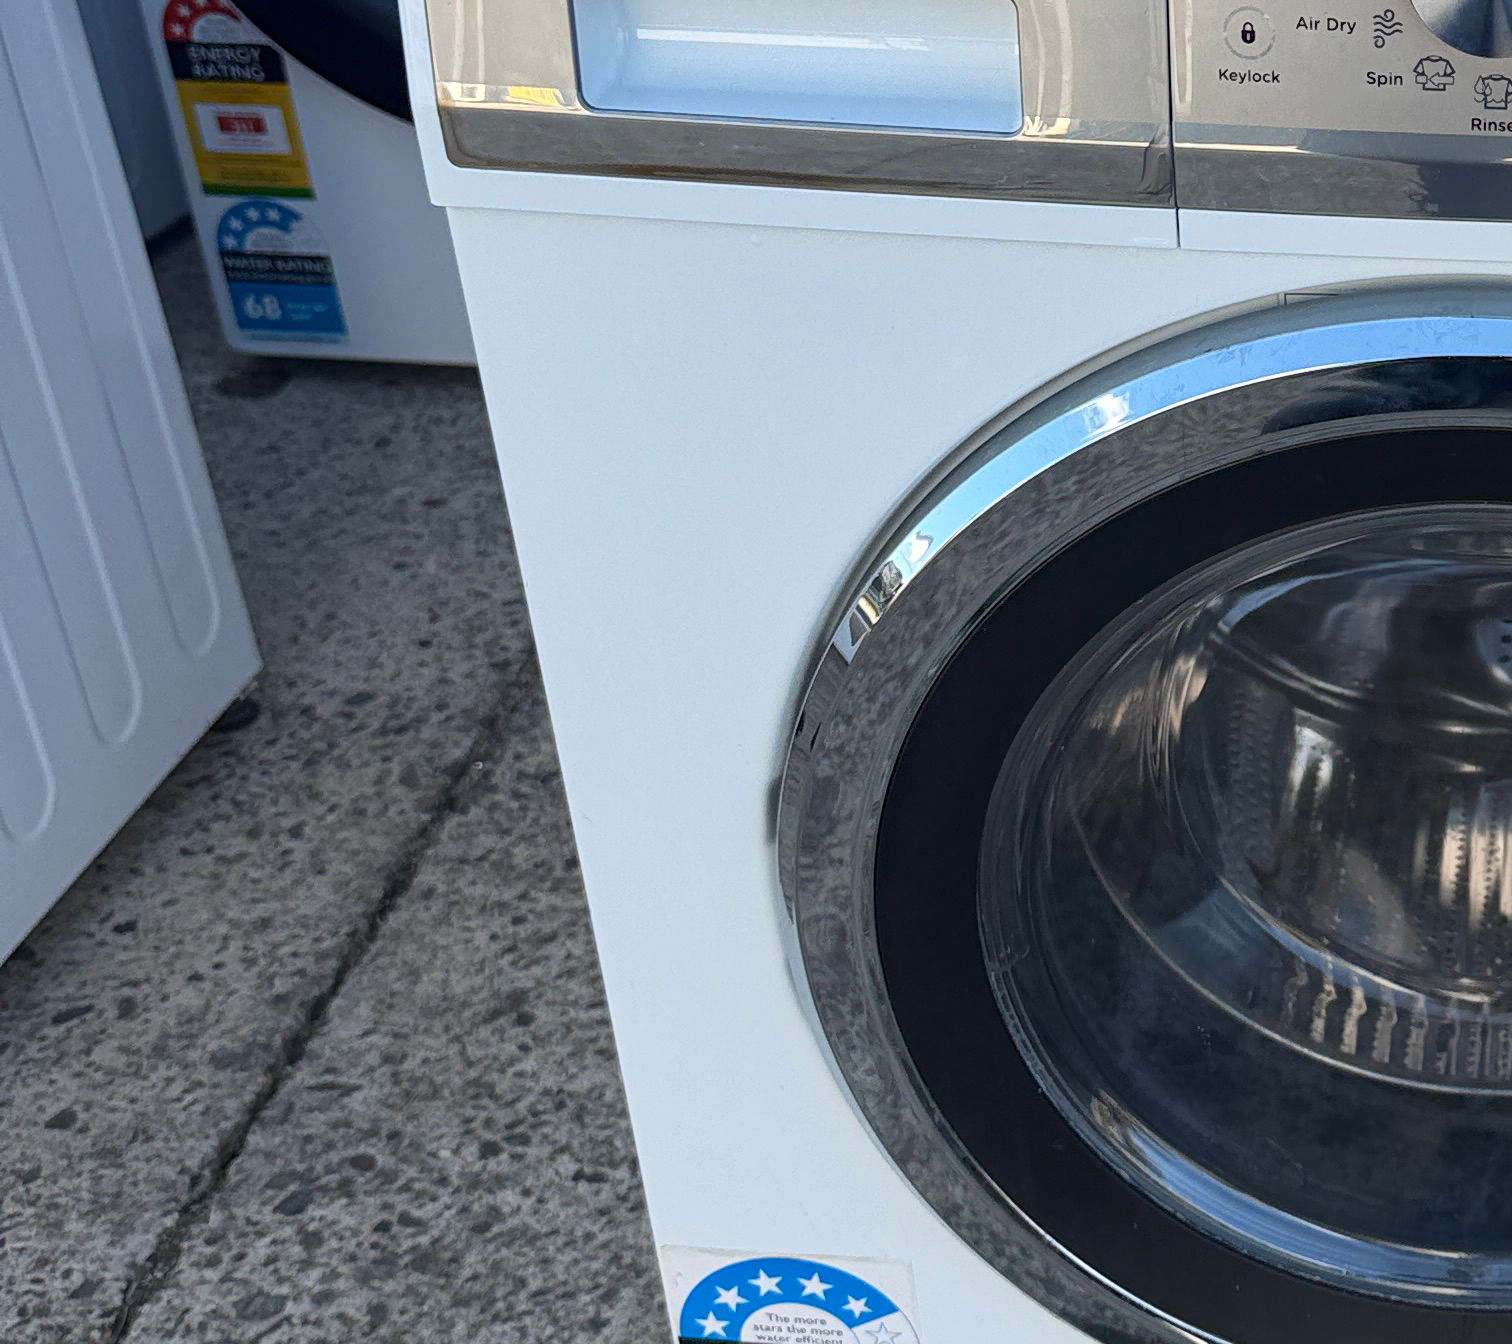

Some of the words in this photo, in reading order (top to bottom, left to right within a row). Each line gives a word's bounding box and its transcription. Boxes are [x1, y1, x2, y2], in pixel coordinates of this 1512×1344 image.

[1295, 16, 1324, 32] Air
[1327, 17, 1357, 35] Dry
[1218, 68, 1281, 87] Keylock
[1366, 71, 1404, 90] Spin
[765, 1312, 790, 1323] The
[794, 1316, 827, 1325] more
[753, 1324, 783, 1333] stars
[786, 1325, 806, 1335] the
[811, 1328, 843, 1336] more
[757, 1335, 791, 1343] water
